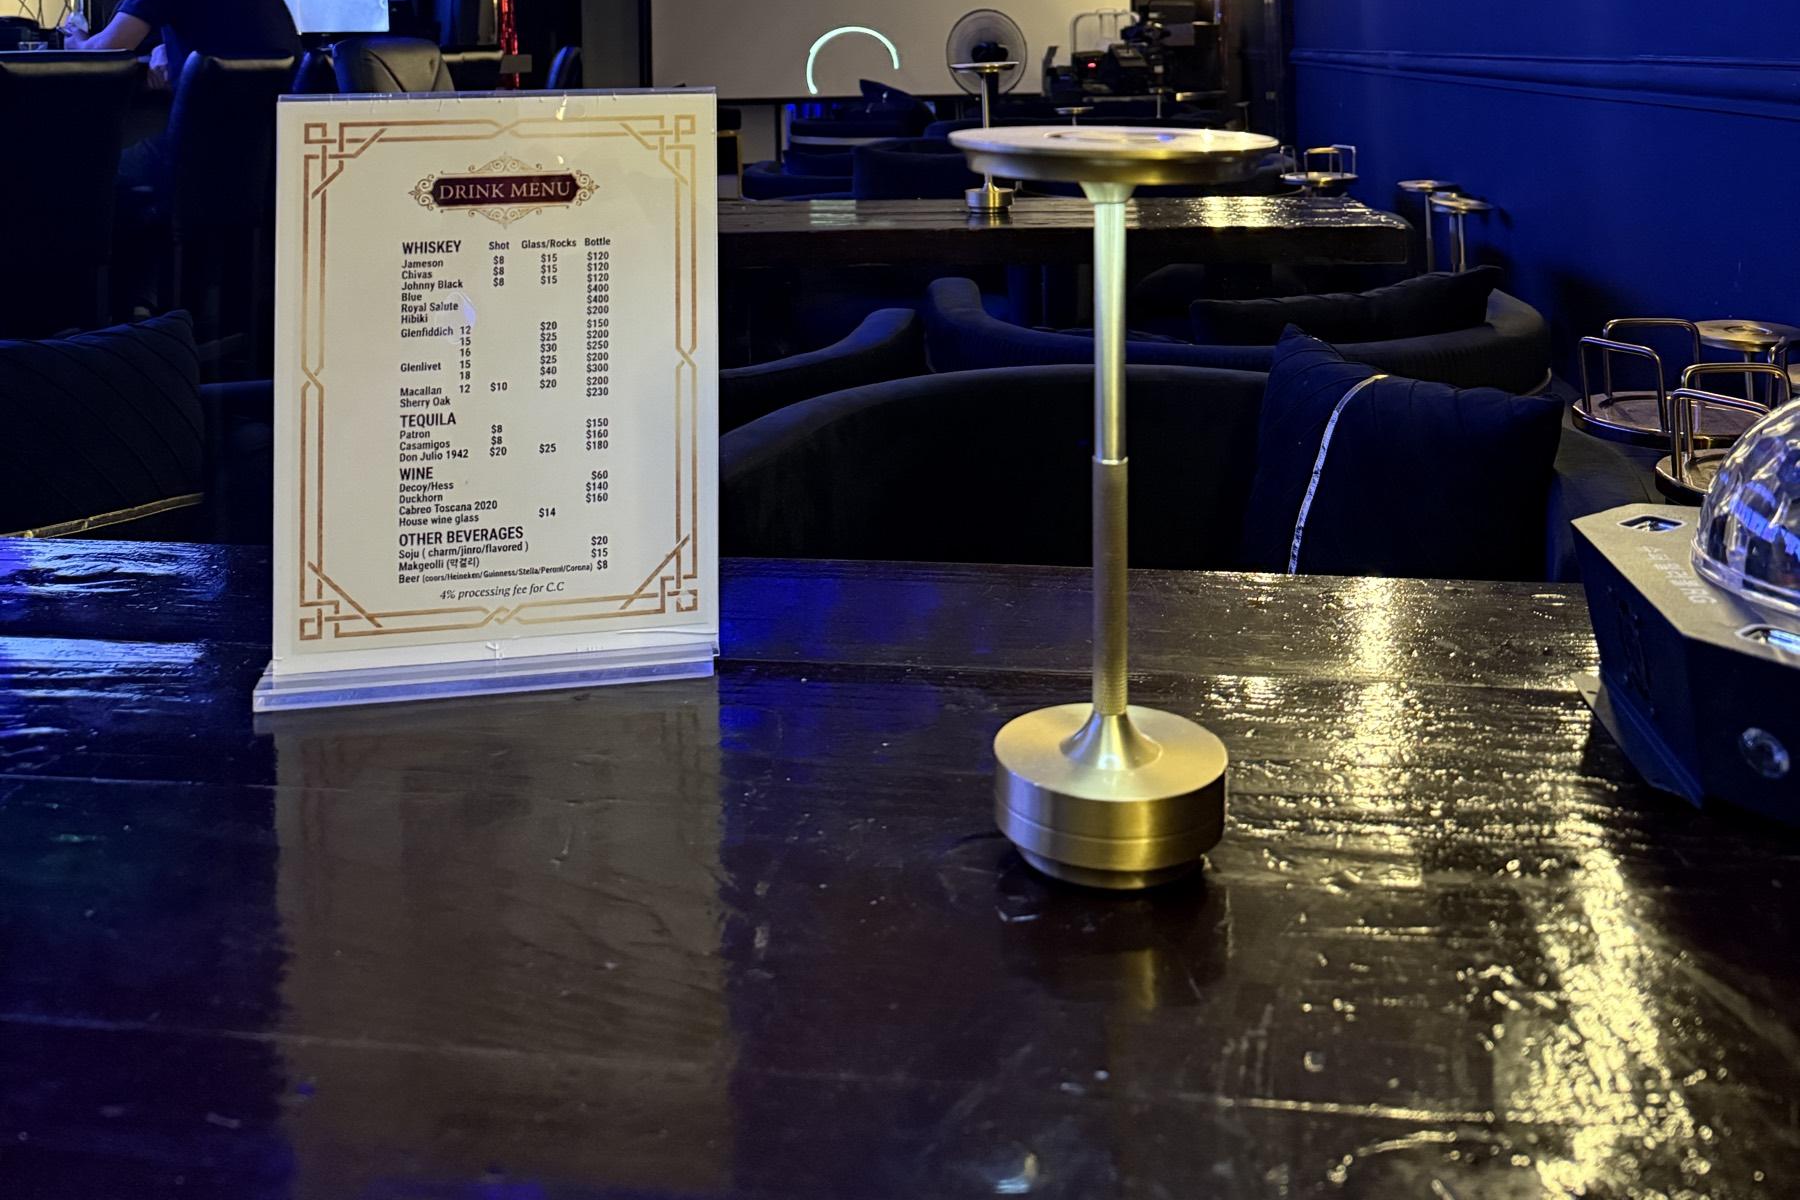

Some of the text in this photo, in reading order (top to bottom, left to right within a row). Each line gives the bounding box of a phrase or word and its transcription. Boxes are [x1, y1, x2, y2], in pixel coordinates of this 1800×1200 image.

[439, 181, 571, 200] DRINK MENU
[402, 237, 611, 255] WHISKEY Shot Glass/Rocks Bottle
[402, 252, 609, 268] Jameson $8 $15 $120
[401, 262, 609, 279] Chivas $8 $15 $120
[401, 273, 609, 292] Johnny Black $8 $15 $120
[401, 283, 609, 302] Blue $400
[401, 294, 609, 314] Royal Salute $400
[401, 305, 609, 324] Hibiki $200
[401, 319, 609, 338] Glenfiddich 12 $20 $150
[460, 330, 609, 346] 15 $25 $200
[460, 340, 609, 357] 16 $30 $250
[400, 352, 609, 372] Glenlivet 15 $25 $200
[460, 363, 609, 380] 18 $40 $300
[400, 376, 609, 397] Macallan 12 $10 $20 $200
[400, 387, 609, 409] Sherry Oak $230
[400, 412, 456, 428] TEQUILA
[400, 418, 609, 439] Patron $8 $150
[400, 430, 608, 451] Casamigos $8 $160
[399, 441, 608, 462] Don Julio 1942 $20 $25 $180
[399, 470, 608, 493] Decoy/Hess $60
[400, 467, 434, 481] WINE
[399, 482, 608, 504] Duckhorn $140
[399, 493, 608, 516] Cabreo Toscana 2020 $160
[399, 508, 556, 527] House wine glass $14
[399, 526, 524, 547] OTHER BEVERAGES
[399, 549, 420, 560] Soju
[428, 542, 523, 558] charm/jinro/flavored
[591, 536, 608, 546] $20
[399, 548, 608, 571] Makgeolli (막걸리) $15
[399, 574, 420, 584] Beer
[597, 560, 608, 570] $8
[440, 582, 565, 600] 4% processing fee for C.C
